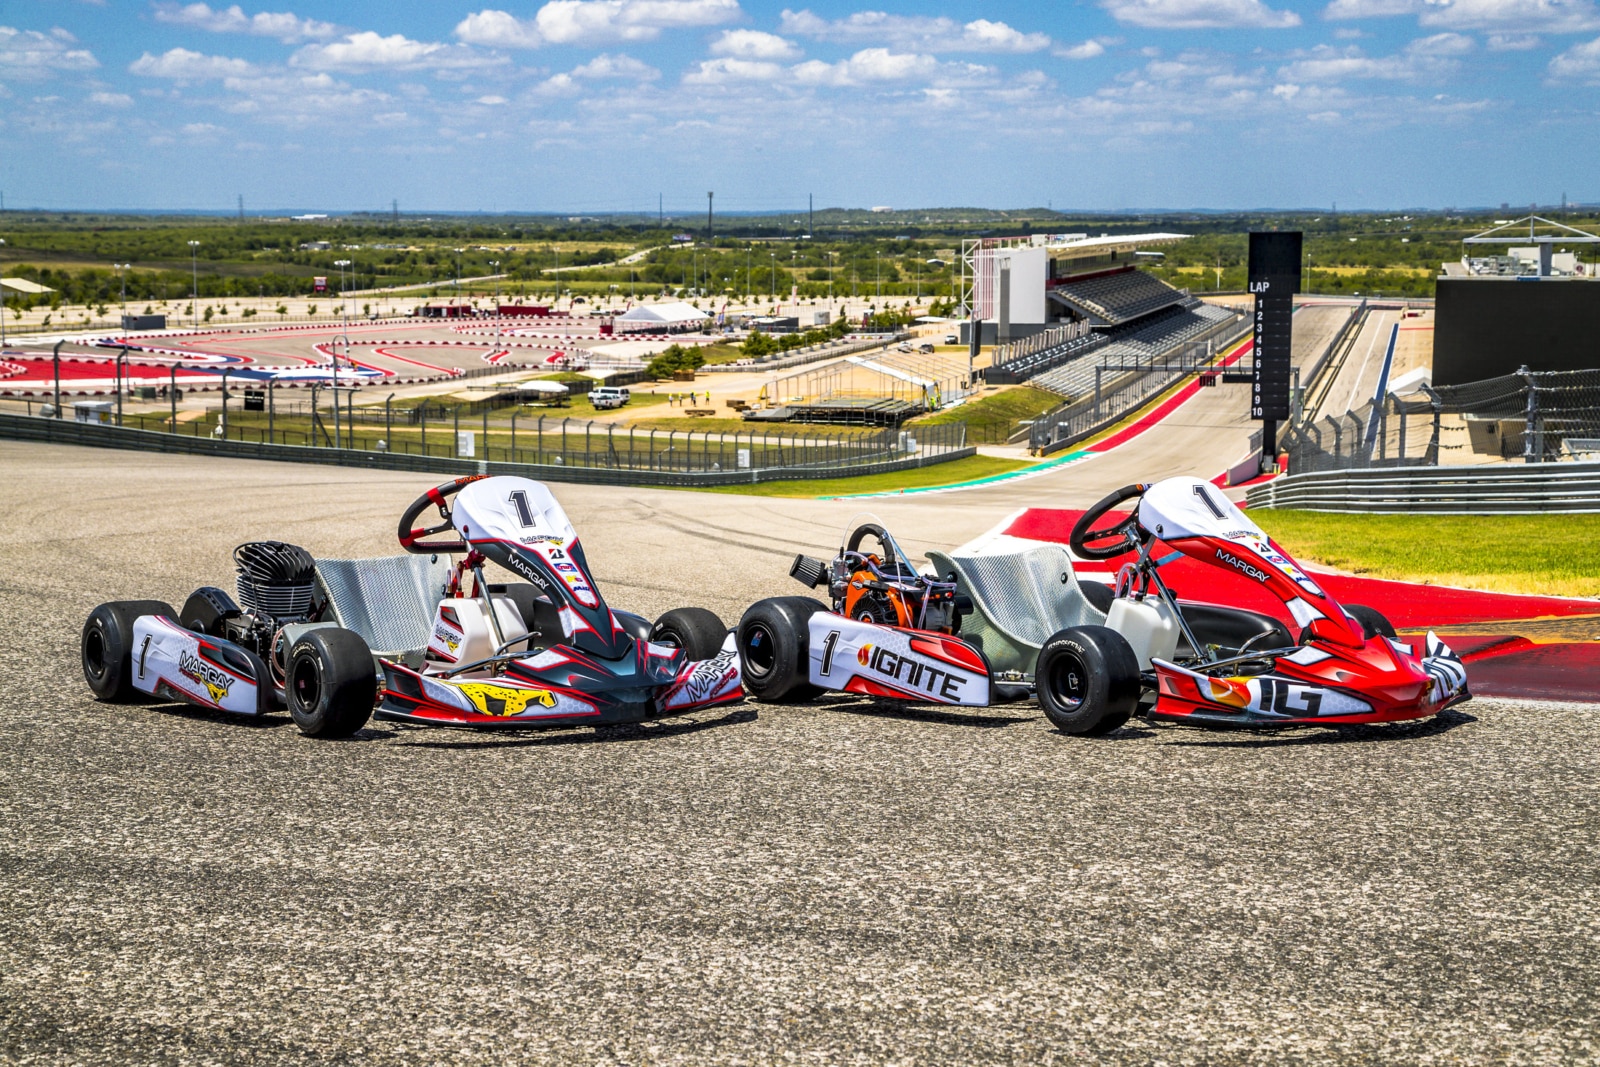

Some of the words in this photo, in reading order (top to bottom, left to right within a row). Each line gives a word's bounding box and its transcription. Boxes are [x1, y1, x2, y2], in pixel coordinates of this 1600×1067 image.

[1250, 281, 1270, 293] LAP
[1258, 299, 1264, 308] 1
[1257, 311, 1263, 321] 2
[1256, 323, 1263, 333] 3
[1256, 335, 1262, 345] 4
[1256, 347, 1262, 357] 5
[1255, 359, 1262, 369] 6
[1255, 371, 1261, 381] 7
[1255, 383, 1261, 393] 8
[1254, 395, 1261, 404] 9
[1252, 407, 1263, 417] 10
[455, 474, 491, 486] MAR
[1193, 485, 1228, 520] 1
[508, 490, 536, 528] 1
[508, 553, 550, 590] MARGAY
[1216, 548, 1271, 583] MARGAY
[138, 634, 153, 680] 1
[820, 630, 841, 677] 1
[179, 650, 236, 690] MARGAY
[685, 648, 738, 703] MARGAY
[869, 646, 968, 702] IGNITE
